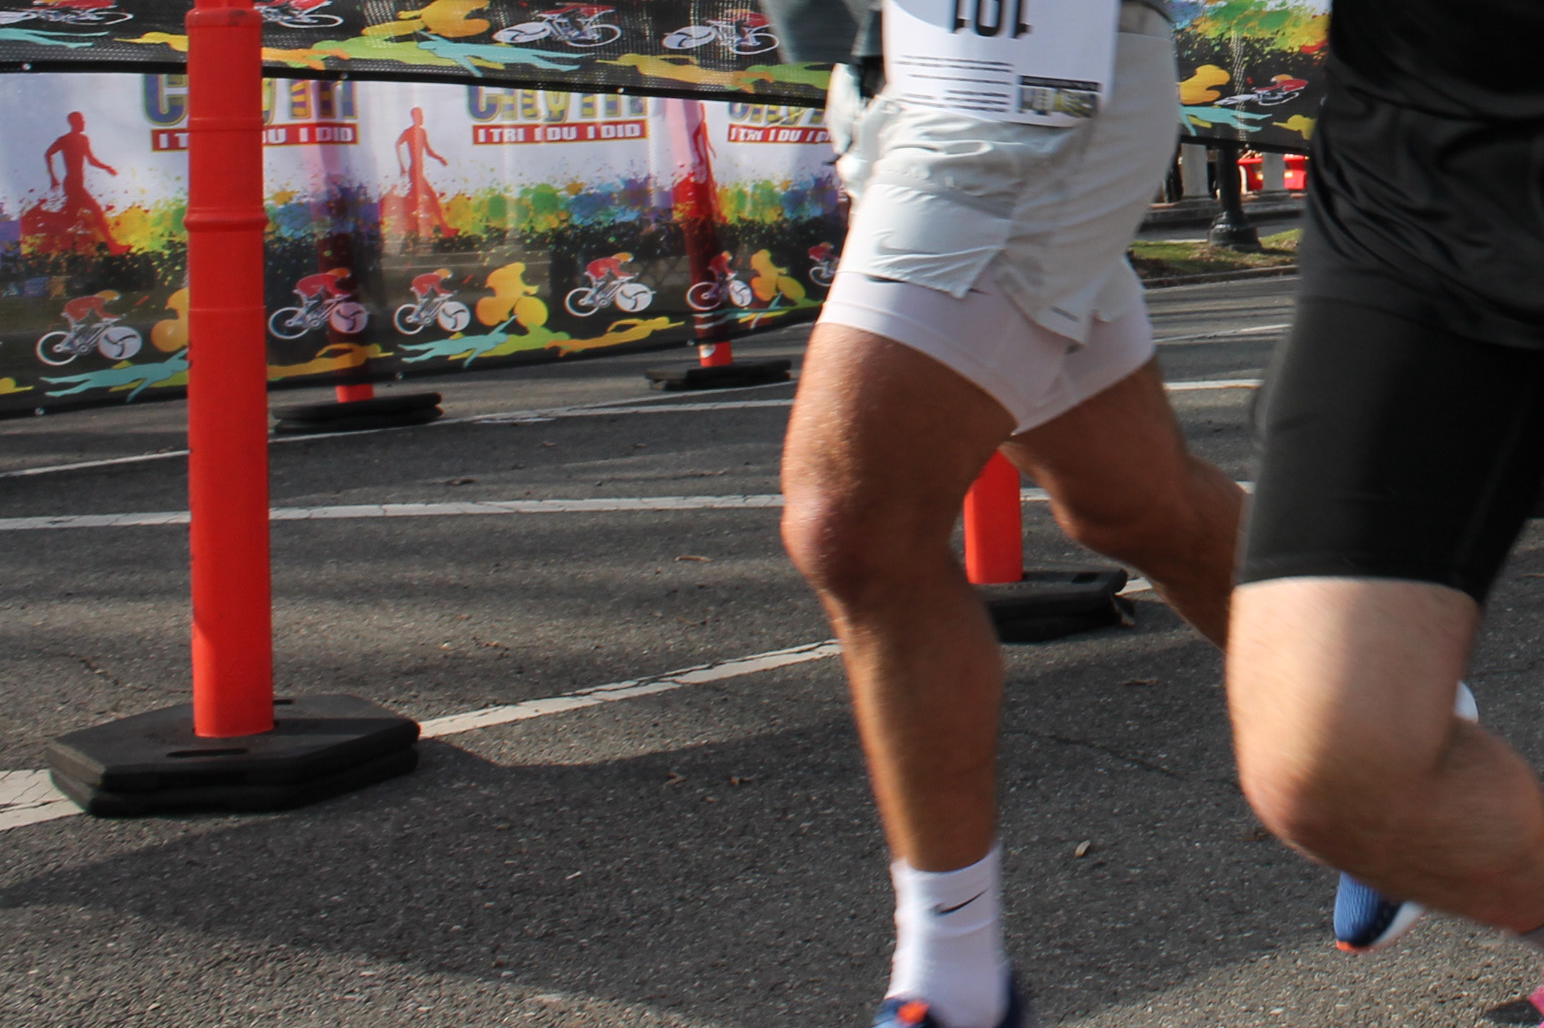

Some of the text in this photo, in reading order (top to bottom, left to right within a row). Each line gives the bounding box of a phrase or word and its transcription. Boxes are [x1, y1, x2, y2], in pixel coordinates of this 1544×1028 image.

[262, 128, 287, 143] U
[316, 126, 354, 142] DID
[478, 128, 486, 143] I
[489, 128, 525, 142] TRI
[587, 125, 595, 139] I
[600, 123, 641, 138] DID
